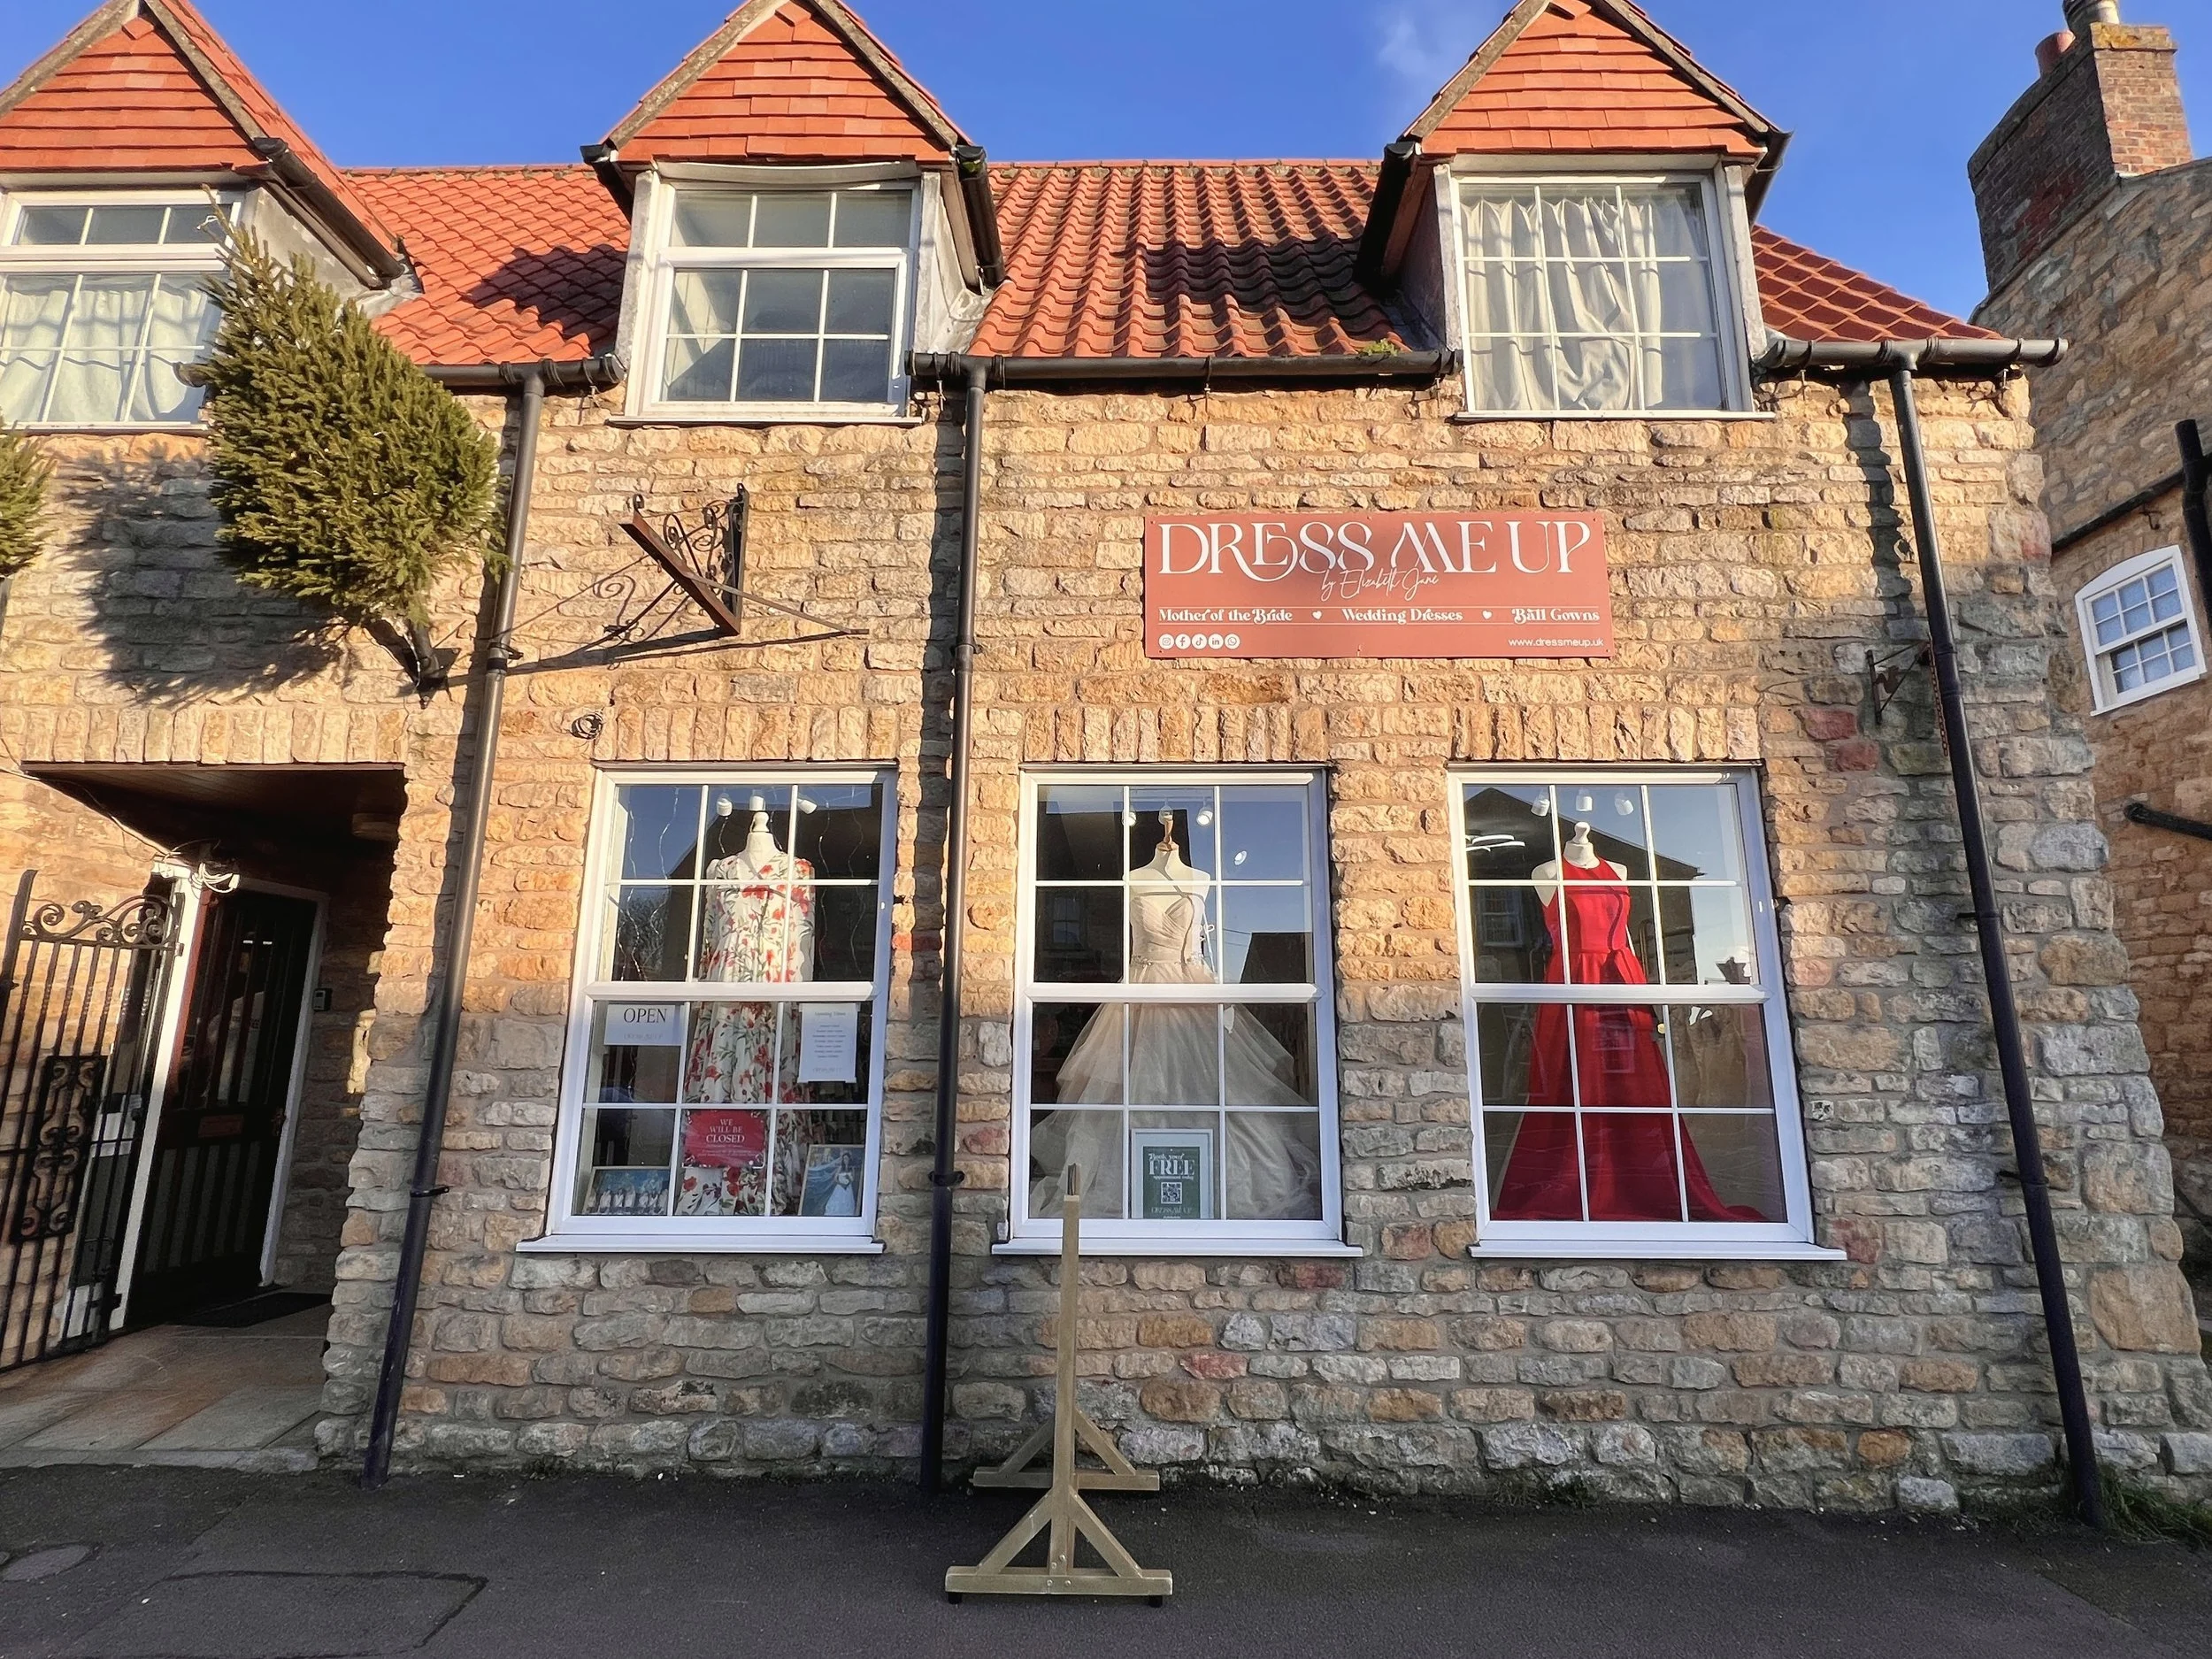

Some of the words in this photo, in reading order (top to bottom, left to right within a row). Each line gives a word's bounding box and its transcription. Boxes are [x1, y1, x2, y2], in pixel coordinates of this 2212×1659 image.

[1158, 520, 1375, 582] DRESS
[1390, 520, 1497, 573] ME
[1505, 520, 1591, 573] UP
[1321, 569, 1336, 602] by
[1340, 567, 1404, 599] Elizabeth
[1402, 567, 1440, 602] Jane
[1158, 608, 1209, 622] Mother
[1210, 608, 1225, 622] of
[1227, 609, 1252, 622] the
[1251, 608, 1294, 625] Bride
[1341, 608, 1407, 625] Wedding
[1409, 608, 1463, 622] Dresses
[1511, 608, 1547, 625] Ball
[1549, 608, 1601, 622] Gowns
[1508, 636, 1605, 649] www.dressmeup.uk
[623, 1007, 668, 1024] OPEN
[705, 1133, 745, 1143] CLOSED
[1149, 1159, 1194, 1175] FREE
